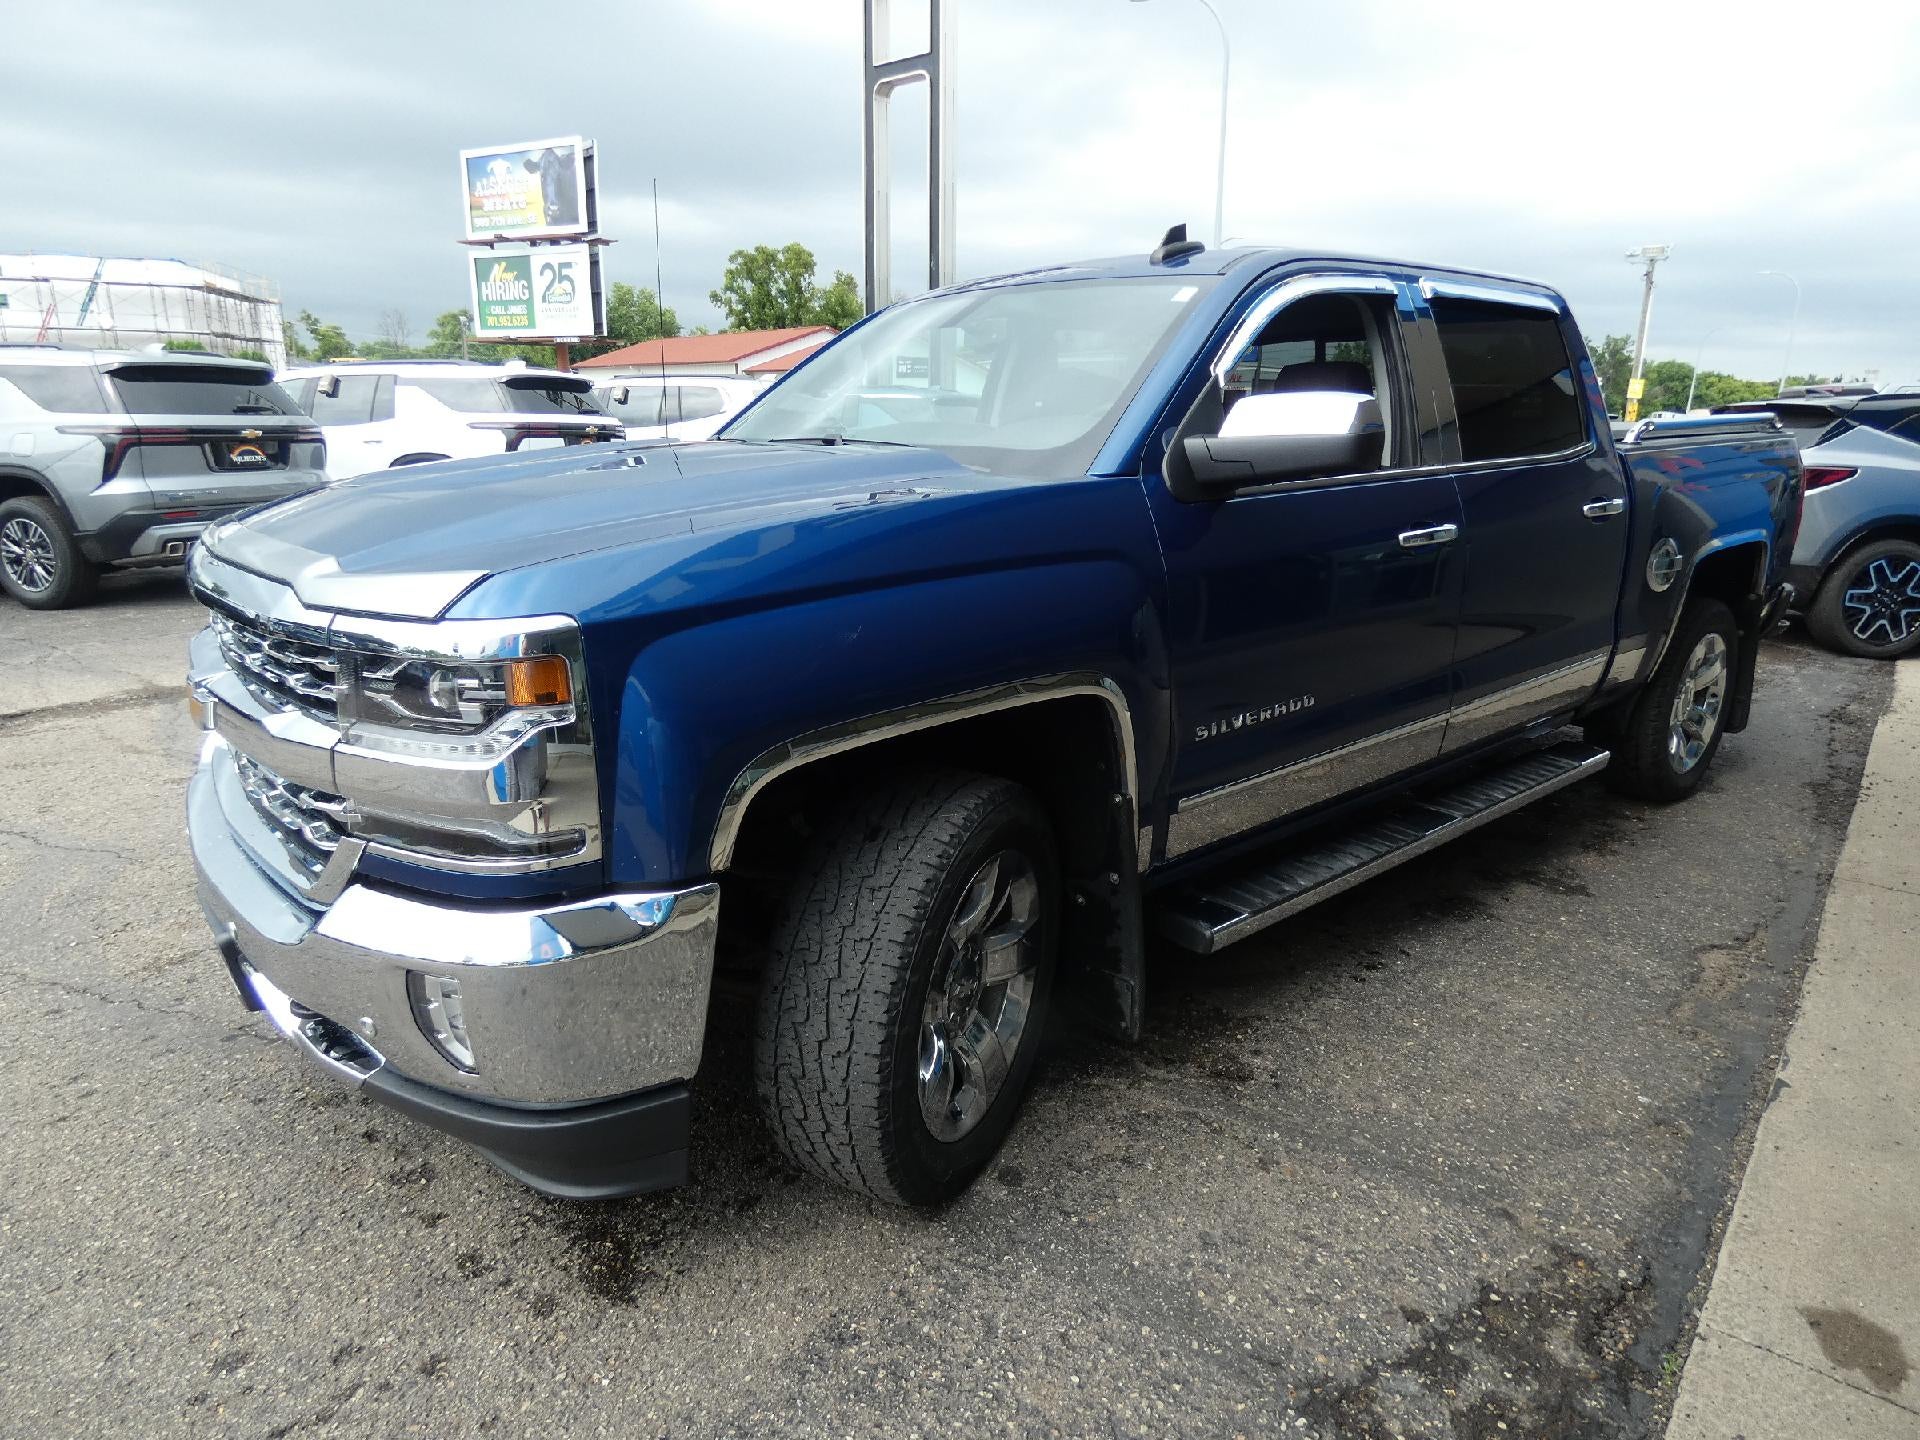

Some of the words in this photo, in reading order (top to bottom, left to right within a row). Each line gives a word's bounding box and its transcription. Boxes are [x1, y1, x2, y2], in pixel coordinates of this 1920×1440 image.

[482, 280, 529, 301] HIRING
[540, 262, 576, 304] 25
[491, 305, 506, 314] CALL
[1194, 694, 1315, 741] SILVERADO
